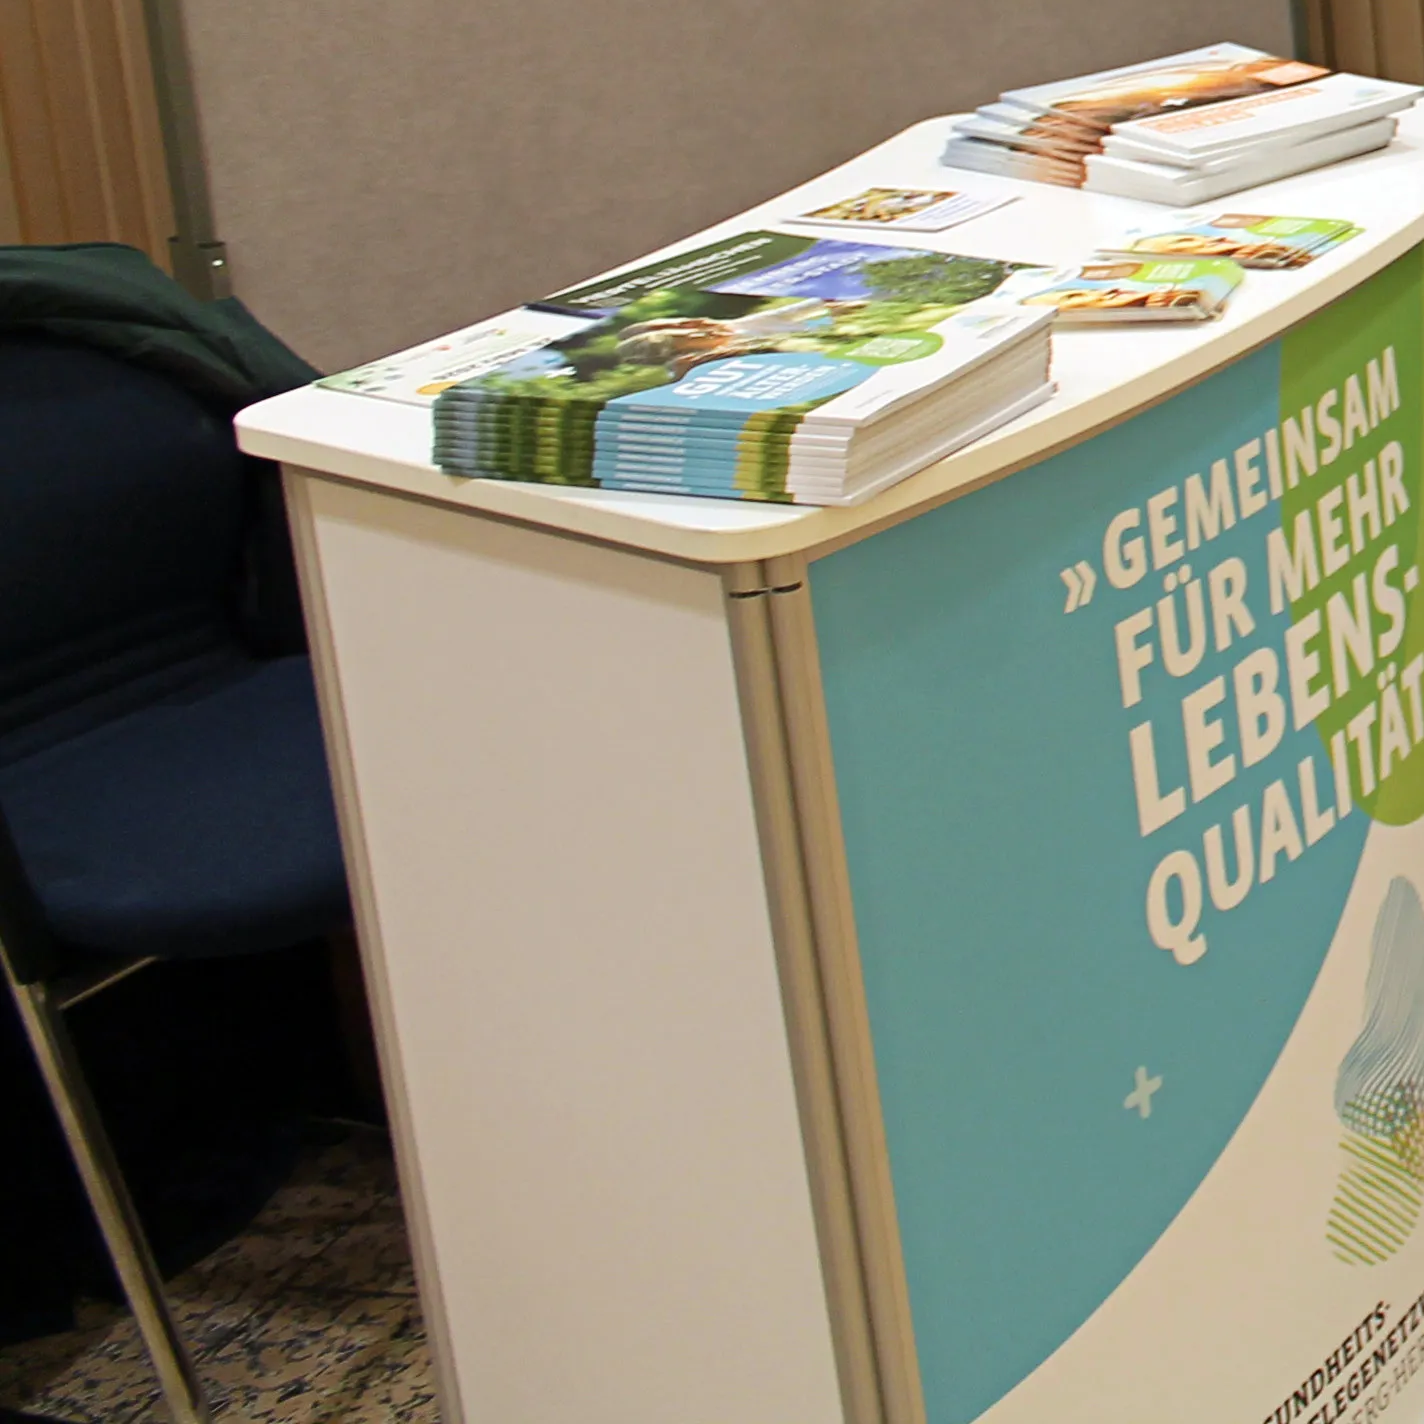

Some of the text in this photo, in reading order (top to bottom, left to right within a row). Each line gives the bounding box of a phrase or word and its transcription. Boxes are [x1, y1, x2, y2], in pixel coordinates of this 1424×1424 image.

[673, 360, 764, 397] GUT
[1113, 439, 1411, 709] FÜR MEHR
[1128, 543, 1421, 838] LEBENS-
